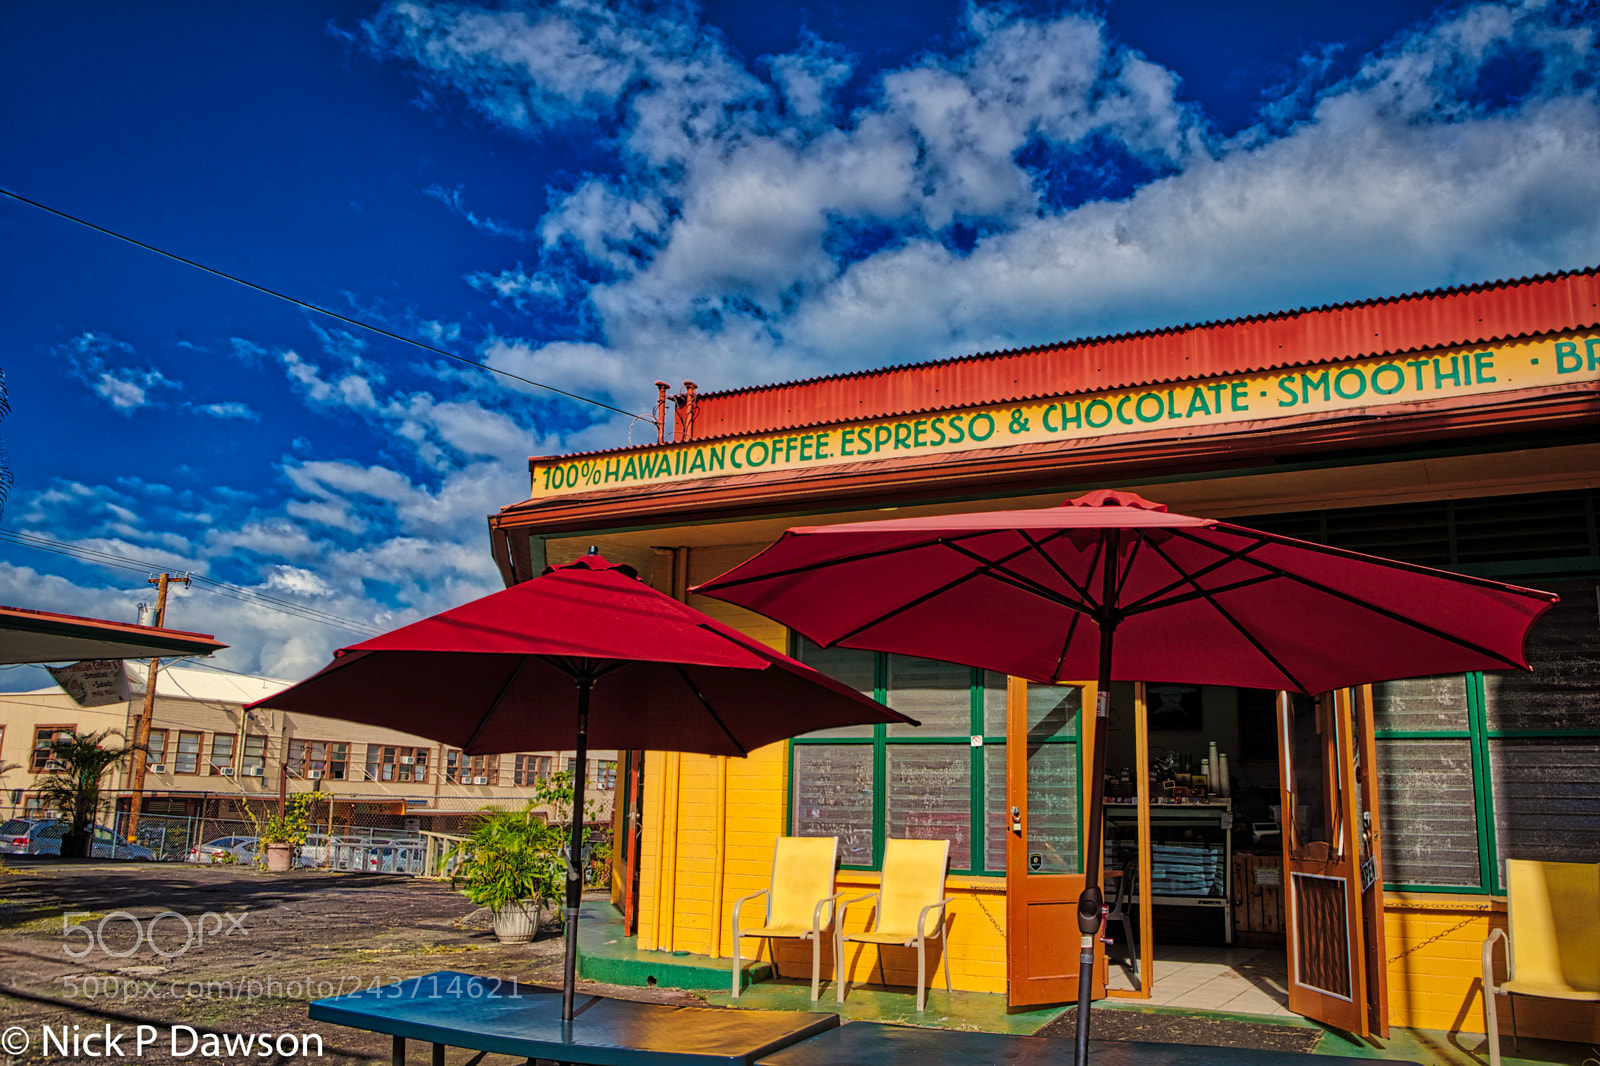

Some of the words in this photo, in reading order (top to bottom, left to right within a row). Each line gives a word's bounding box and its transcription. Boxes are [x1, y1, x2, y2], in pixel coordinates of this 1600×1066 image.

[542, 461, 602, 491] 100%
[604, 445, 726, 483] HAWAIIAN
[840, 413, 995, 457] ESPRESSO
[1008, 409, 1030, 434] &
[1042, 382, 1249, 433] CHOCOLATE
[1278, 351, 1497, 408] SMOOTHIE
